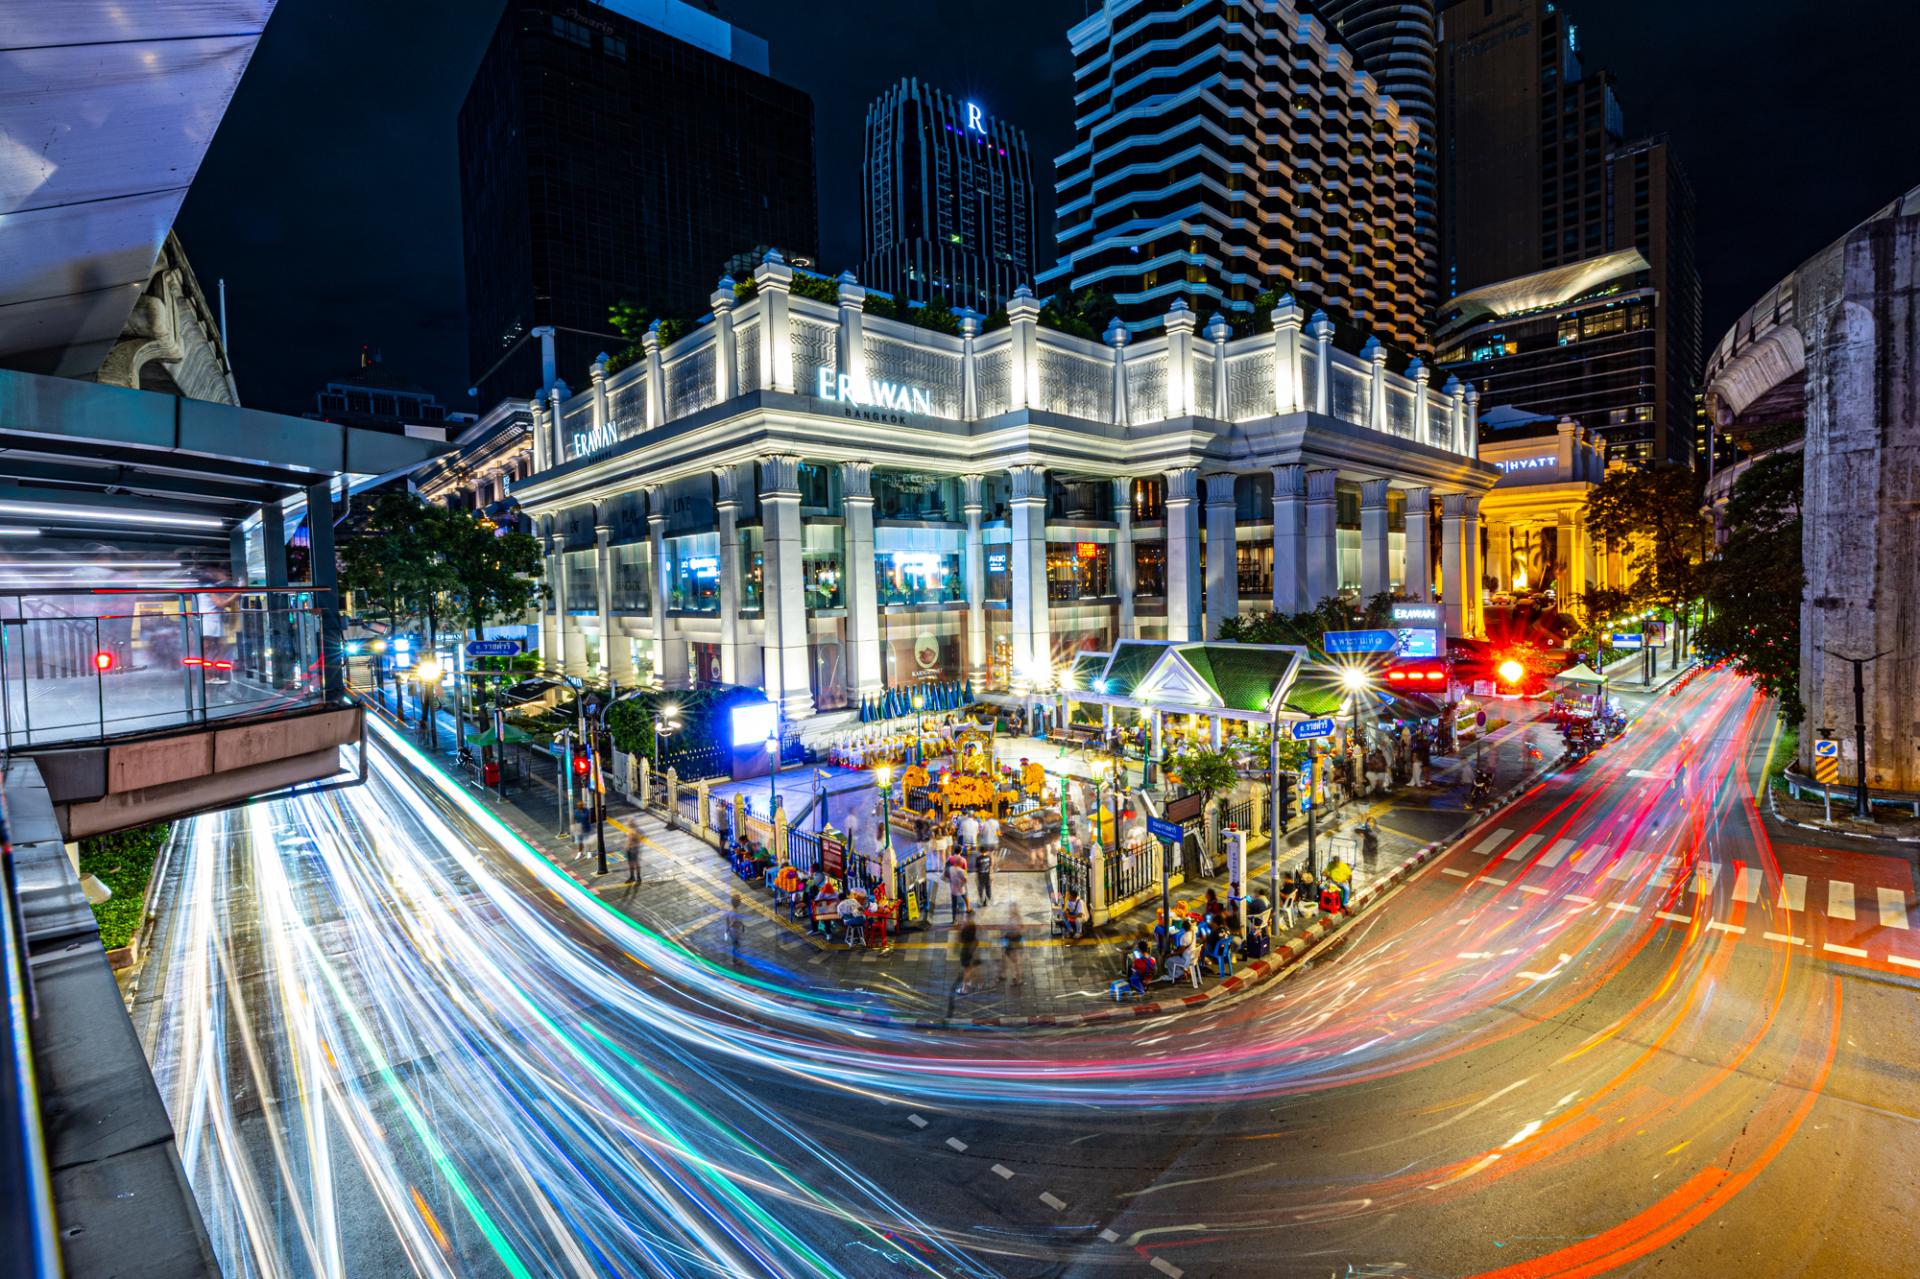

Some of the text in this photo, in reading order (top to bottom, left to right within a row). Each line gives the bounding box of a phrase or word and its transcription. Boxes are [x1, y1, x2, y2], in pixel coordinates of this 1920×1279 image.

[968, 102, 987, 134] R
[818, 365, 933, 417] ERAWAN
[844, 408, 906, 425] BANGKOK
[574, 420, 618, 458] ERAWAN
[1510, 456, 1556, 470] HYATT
[1394, 607, 1436, 619] ERAWAN
